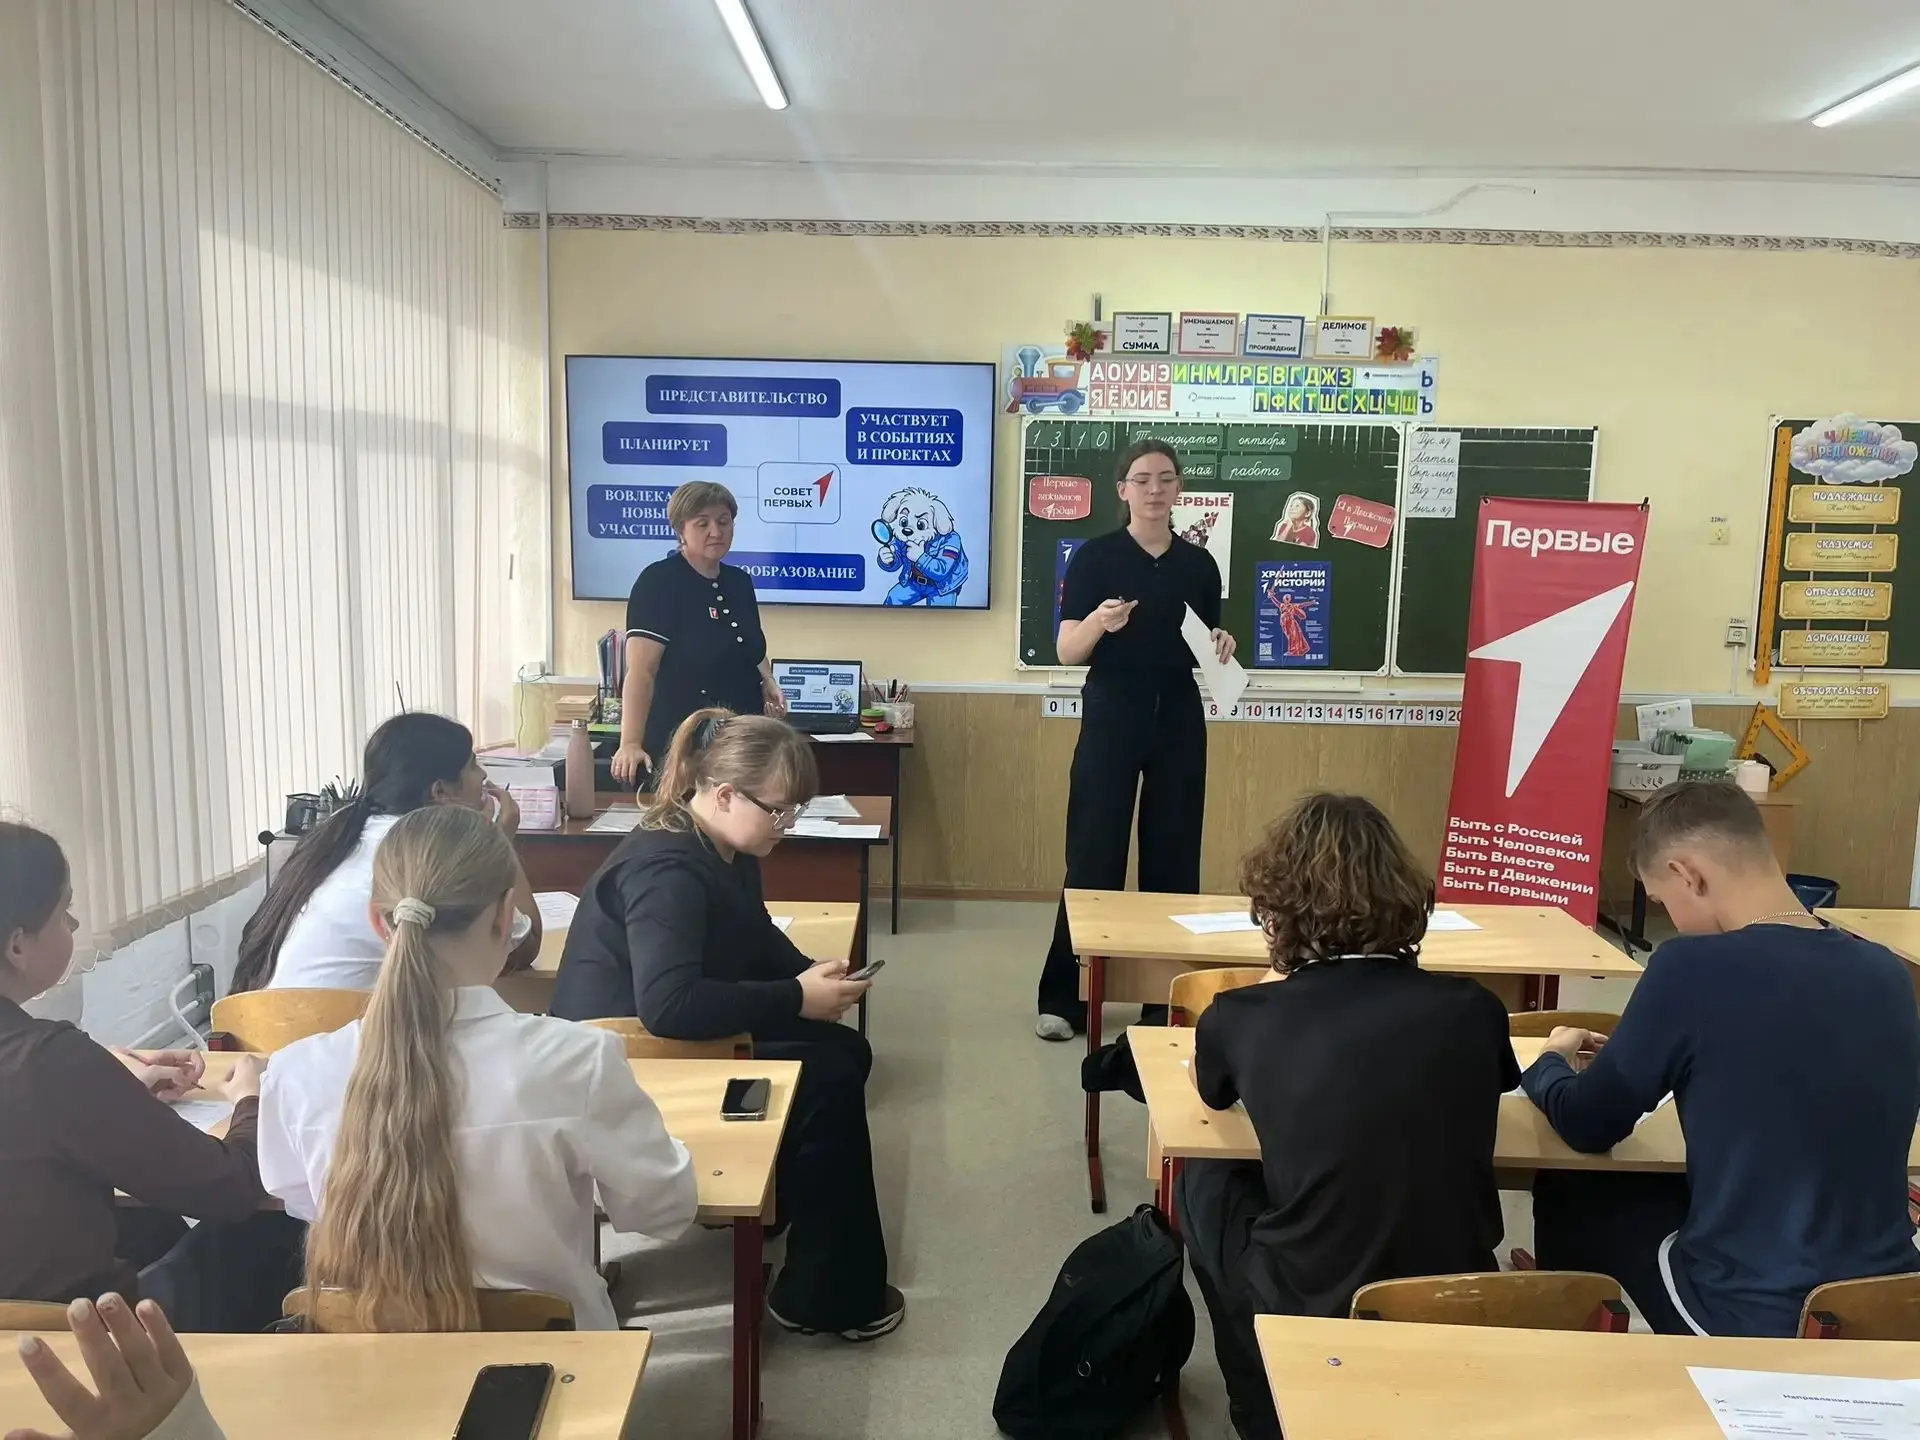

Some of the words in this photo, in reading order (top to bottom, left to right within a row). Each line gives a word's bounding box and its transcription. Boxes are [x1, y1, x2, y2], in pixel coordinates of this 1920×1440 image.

[1184, 318, 1234, 326] УМЕНЬШАЕМОЕ
[1322, 322, 1367, 330] ДЕЛИМОЕ
[1122, 342, 1160, 350] СУММА
[1249, 344, 1296, 352] ПРОИЗВЕДЕНИЕ
[660, 389, 828, 405] ПРЕДСТАВИТЕЛЬСТВО
[860, 414, 950, 426] УЧАСТВУЕТ
[858, 431, 866, 442] В
[870, 431, 955, 444] СОБЫТИЯХ
[1238, 432, 1286, 450] октября
[1824, 428, 1882, 444] ЧЛЕНЫ
[620, 438, 710, 451] ПЛАНИРУЕТ
[858, 448, 868, 460] И
[872, 448, 952, 462] ПРОЕКТАХ
[1808, 444, 1898, 464] ПРЕДЛОЖЕНИЯ
[1229, 461, 1282, 479] работа
[1043, 477, 1078, 490] Первые
[605, 490, 672, 502] ВОВЛЕКА
[774, 487, 812, 496] СОВЕТ
[1813, 491, 1884, 504] ПОДЛЕЖАЩЕЕ
[764, 498, 812, 508] ПЕРВЫХ
[1173, 496, 1230, 506] ЕРВЫЕ
[1338, 501, 1346, 510] Я
[622, 506, 668, 520] НОВЫ
[1486, 520, 1635, 558] Первые
[1816, 540, 1874, 550] СКАЗУЕМОЕ
[1262, 570, 1326, 578] ХРАНИТЕЛИ
[1805, 588, 1876, 597] ОПРЕДЕЛЕНИЕ
[1806, 634, 1870, 643] ДОПОЛНЕНИЕ
[1792, 686, 1880, 696] ОБСТОЯТЕЛЬСТВО
[1050, 701, 1058, 712] 0
[1070, 702, 1077, 712] 1
[1210, 704, 1218, 716] 8
[1246, 704, 1262, 716] 10
[1268, 705, 1282, 717] 11
[1286, 706, 1302, 718] 12
[1306, 706, 1322, 718] 13
[1327, 706, 1343, 718] 14
[1348, 707, 1363, 719] 15
[1368, 708, 1384, 720] 16
[1388, 708, 1404, 720] 17
[1408, 709, 1424, 720] 18
[1428, 710, 1444, 722] 19
[1450, 817, 1491, 832] Быть
[1494, 824, 1504, 832] с
[1508, 823, 1582, 846] Россией
[1448, 832, 1489, 846] Быть
[1493, 836, 1590, 862] Человеком
[1446, 847, 1488, 861] Быть
[1491, 852, 1555, 872] Вместе
[1444, 862, 1486, 876] Быть
[1489, 868, 1499, 878] в
[1501, 868, 1594, 894] Движении
[1442, 876, 1484, 891] Быть
[1488, 882, 1569, 905] Первыми
